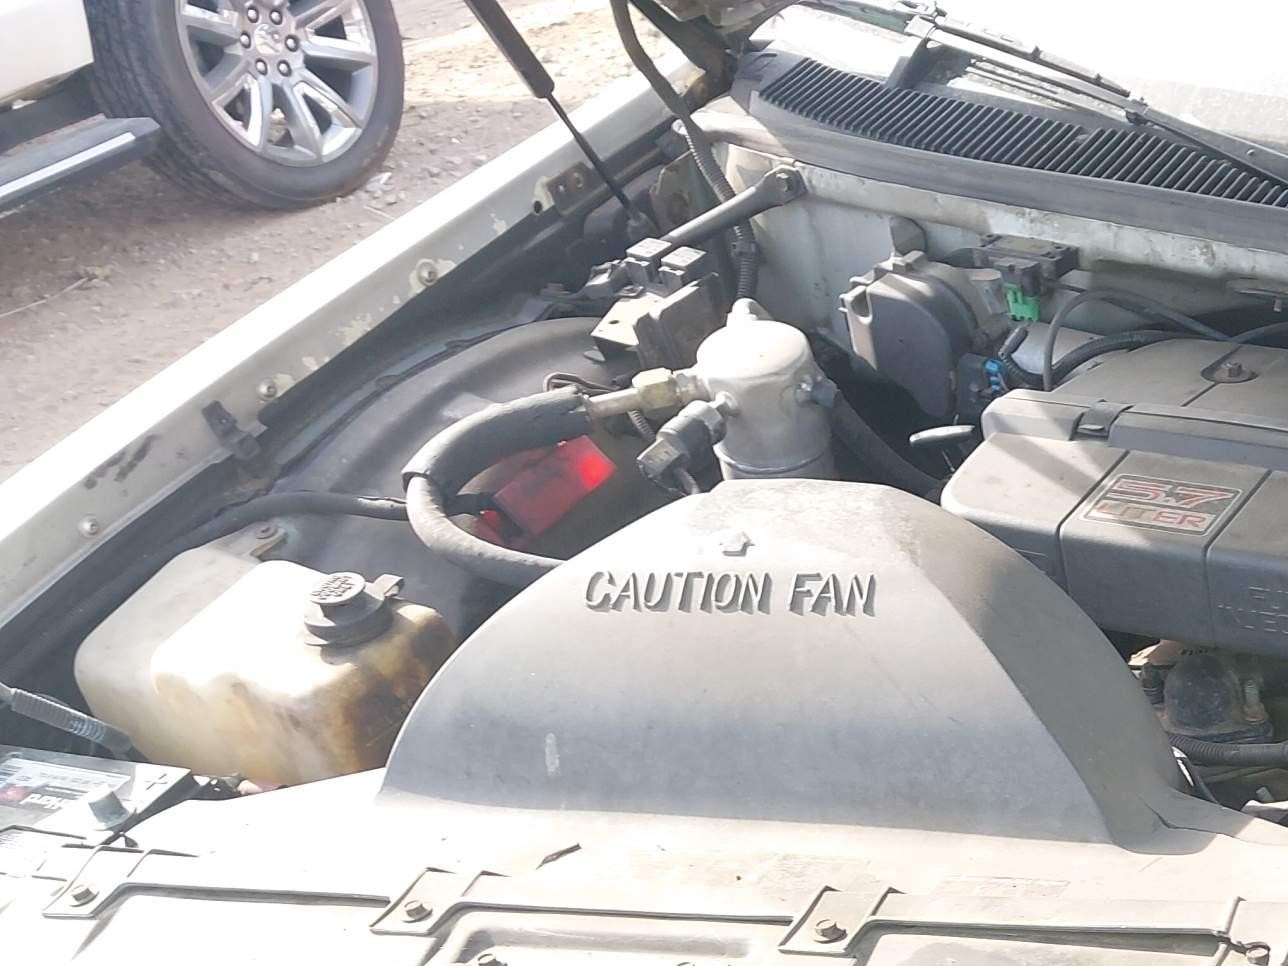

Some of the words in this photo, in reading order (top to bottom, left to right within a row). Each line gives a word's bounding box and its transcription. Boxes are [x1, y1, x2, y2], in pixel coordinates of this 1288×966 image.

[1106, 478, 1237, 509] 5.7
[1096, 499, 1207, 528] LITER
[585, 571, 773, 614] CAUTION
[788, 572, 877, 617] FAN
